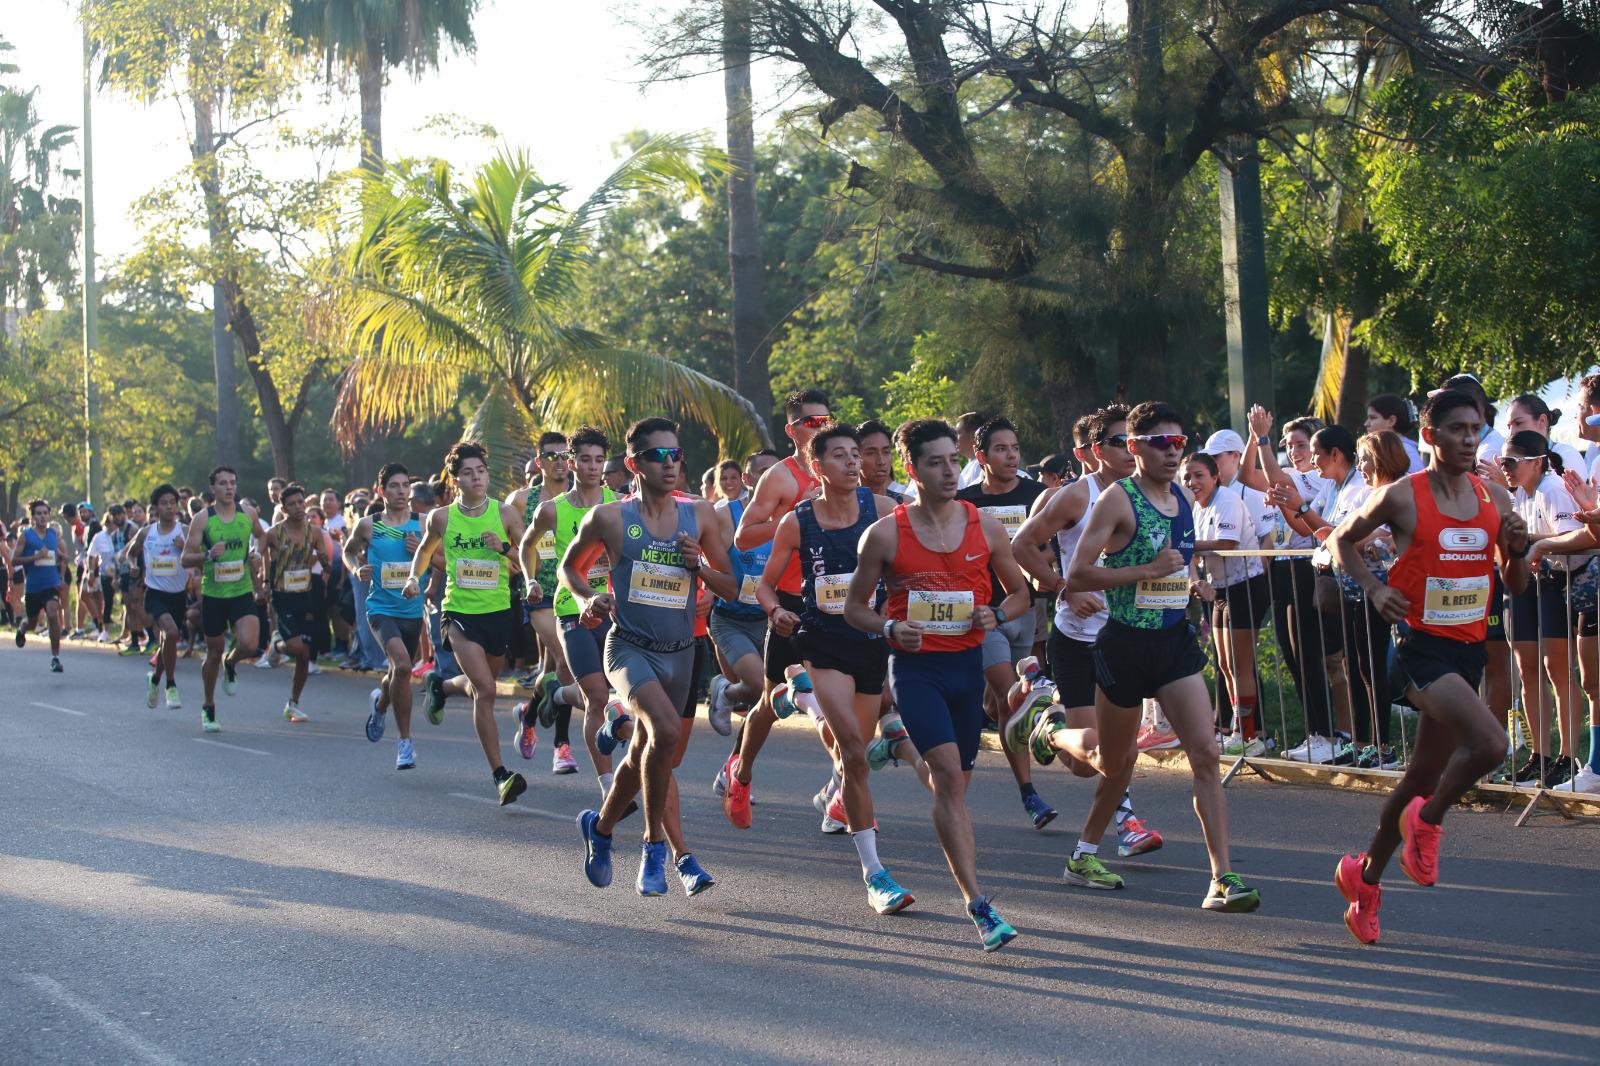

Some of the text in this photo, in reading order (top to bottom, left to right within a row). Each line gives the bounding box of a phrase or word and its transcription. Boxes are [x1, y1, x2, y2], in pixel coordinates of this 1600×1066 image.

[1000, 516, 1020, 525] VAJAL
[1142, 582, 1149, 591] D.
[834, 588, 849, 599] MO
[1442, 594, 1478, 606] R. REYES
[930, 603, 954, 622] 154
[649, 641, 677, 652] NIKE
